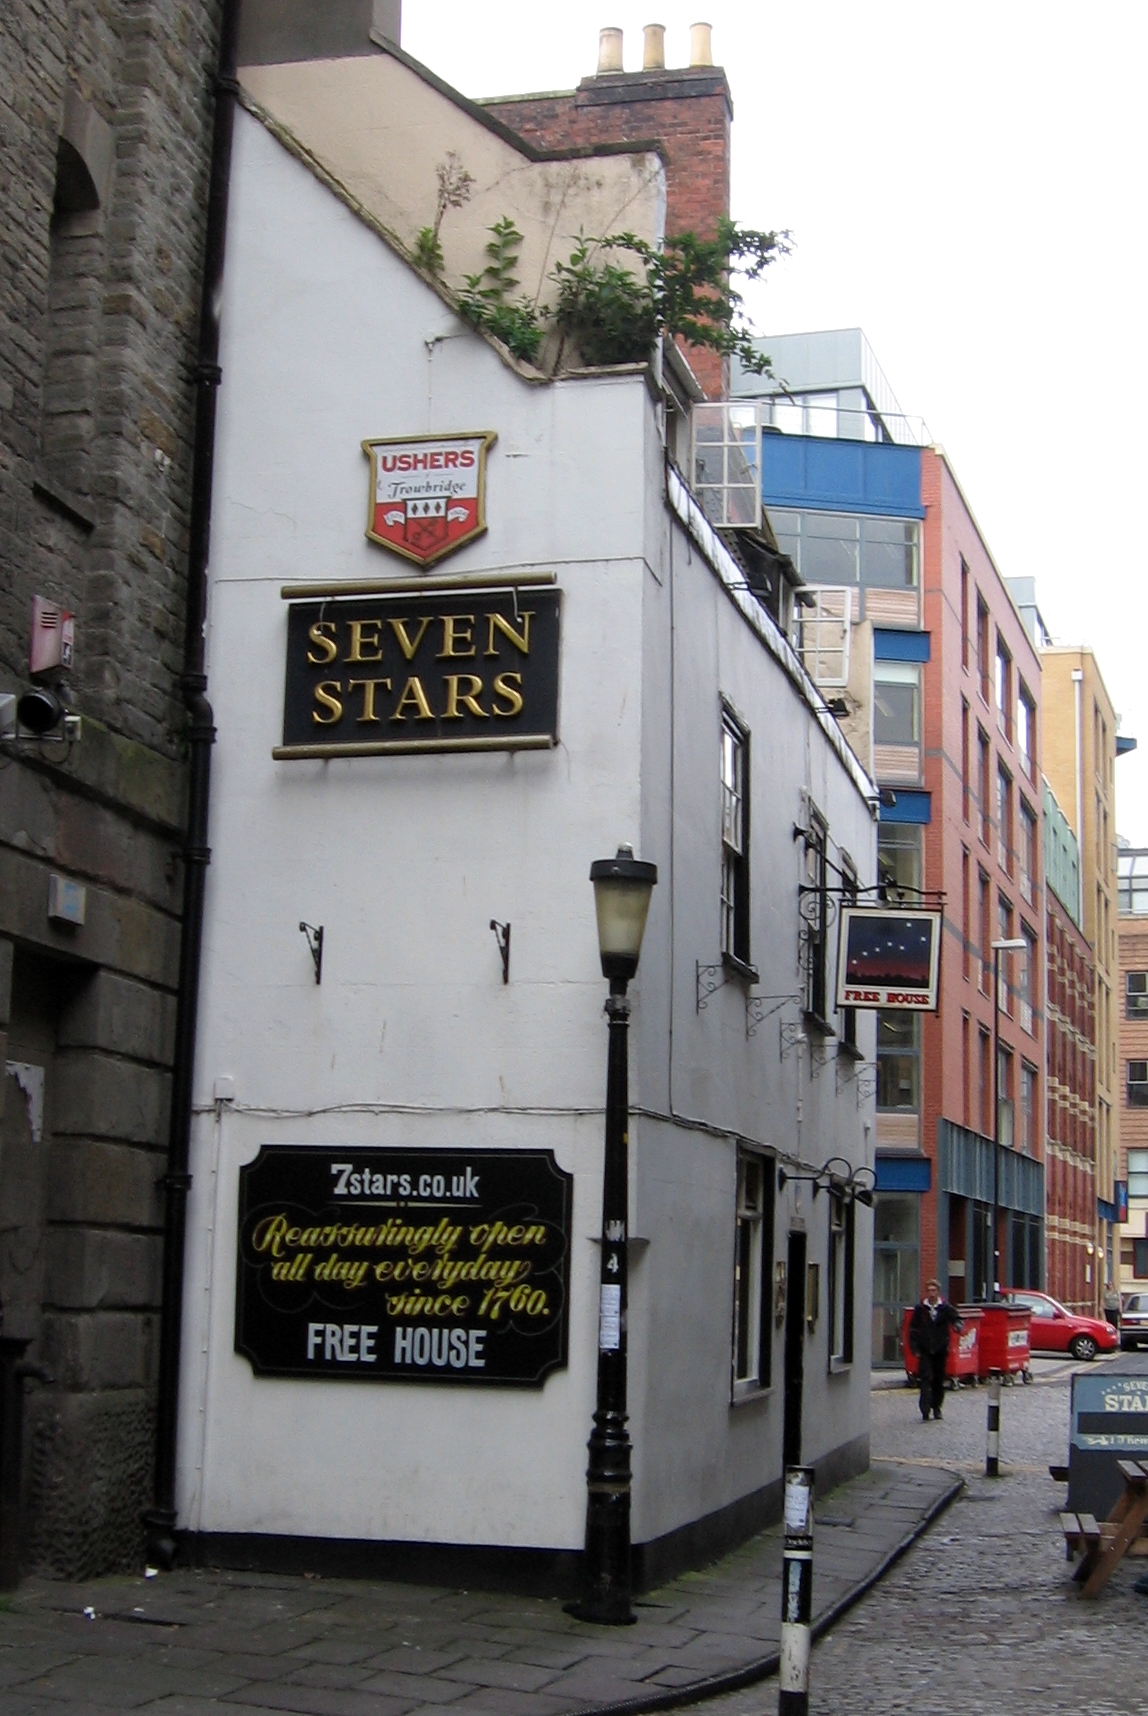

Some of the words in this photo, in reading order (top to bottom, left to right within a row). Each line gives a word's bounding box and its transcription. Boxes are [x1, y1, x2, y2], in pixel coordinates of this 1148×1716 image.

[382, 450, 475, 472] USHERS
[388, 480, 466, 498] Trowbridge
[306, 611, 536, 664] SEVEN
[312, 672, 523, 725] STARS
[845, 990, 880, 1002] FREE
[886, 992, 930, 1005] HOUSE
[331, 1163, 480, 1198] 7stars.co.uk
[252, 1213, 463, 1257] Reassuringly
[469, 1221, 546, 1253] open
[271, 1253, 314, 1281] all
[314, 1253, 369, 1289] day
[374, 1253, 531, 1289] everyday
[606, 1253, 619, 1273] 4
[385, 1288, 469, 1316] since
[477, 1284, 550, 1320] 1760.
[307, 1323, 379, 1362] FREE
[394, 1326, 487, 1369] HOUSE
[1105, 1394, 1148, 1412] STA
